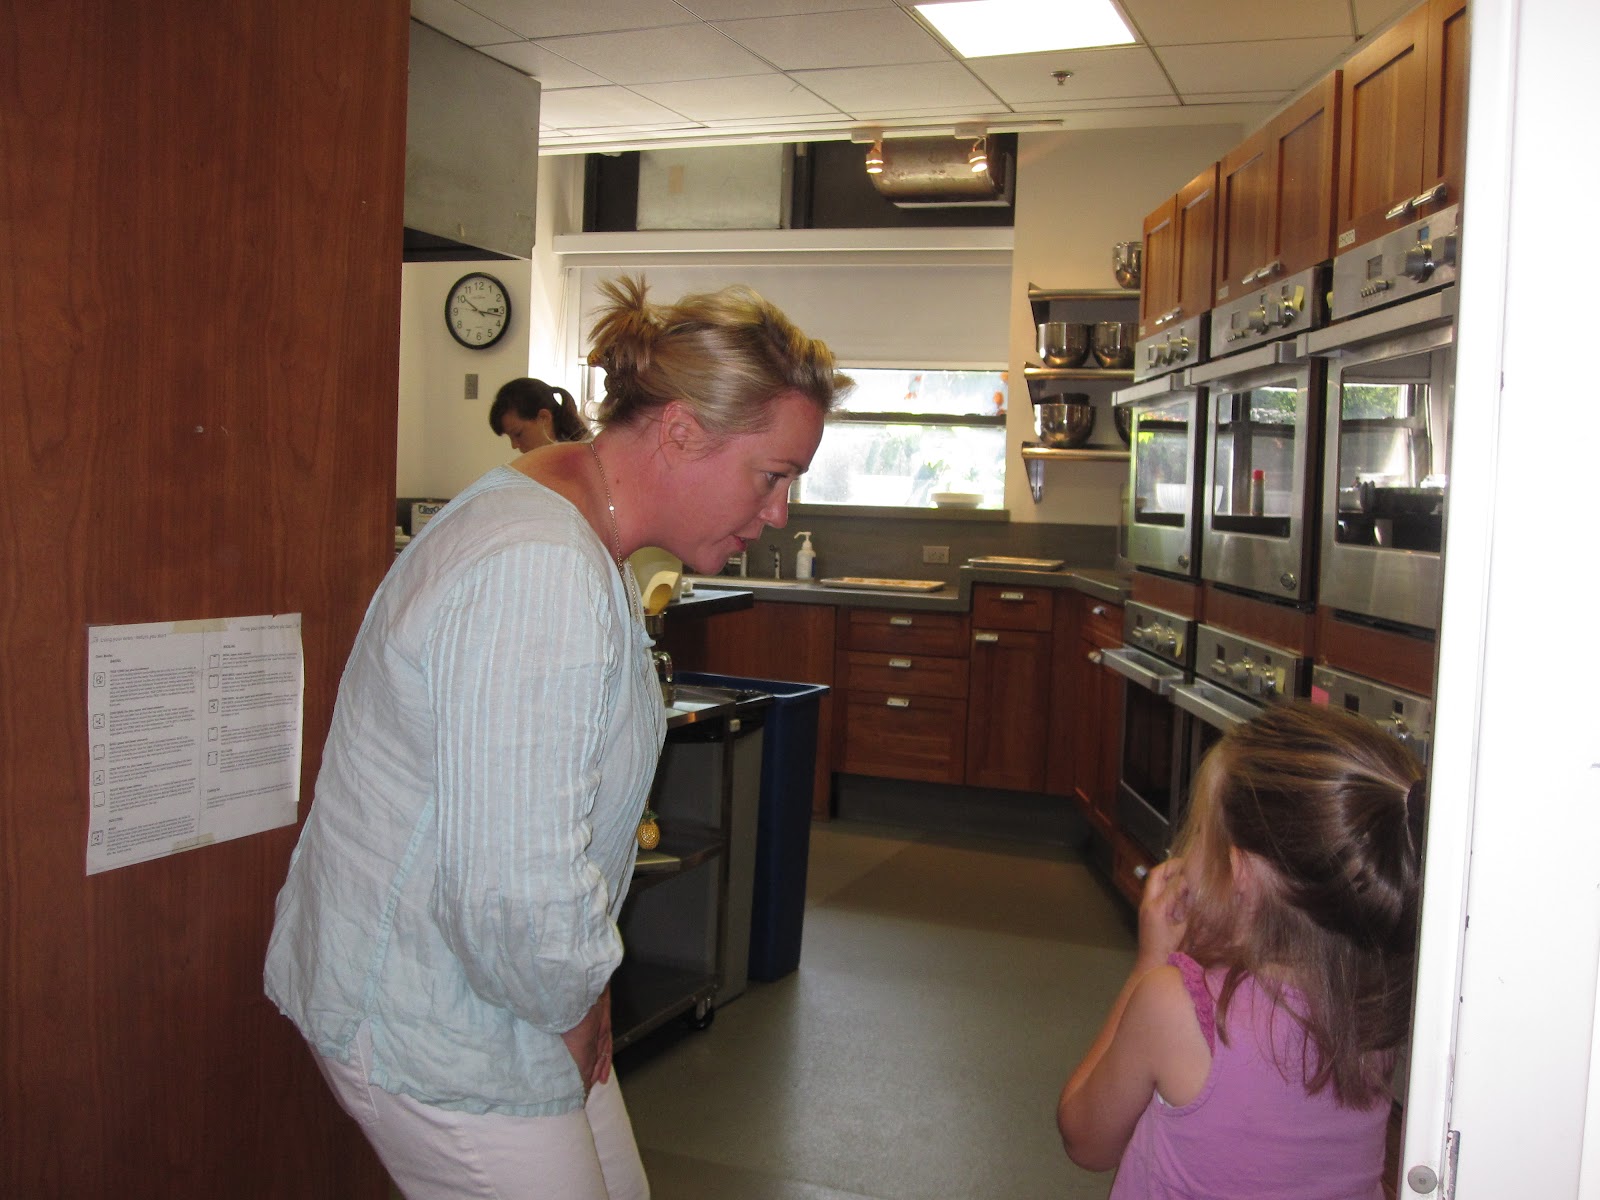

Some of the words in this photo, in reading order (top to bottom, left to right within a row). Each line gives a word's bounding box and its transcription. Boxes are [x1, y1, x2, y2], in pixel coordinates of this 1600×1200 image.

[474, 281, 484, 290] 12
[465, 286, 471, 294] 11
[457, 295, 465, 303] 10
[496, 294, 502, 302] 2
[453, 308, 458, 316] 9
[499, 306, 504, 314] 3
[457, 320, 462, 329] 8
[466, 329, 471, 337] 7
[477, 332, 482, 340] 6
[488, 329, 493, 337] 5
